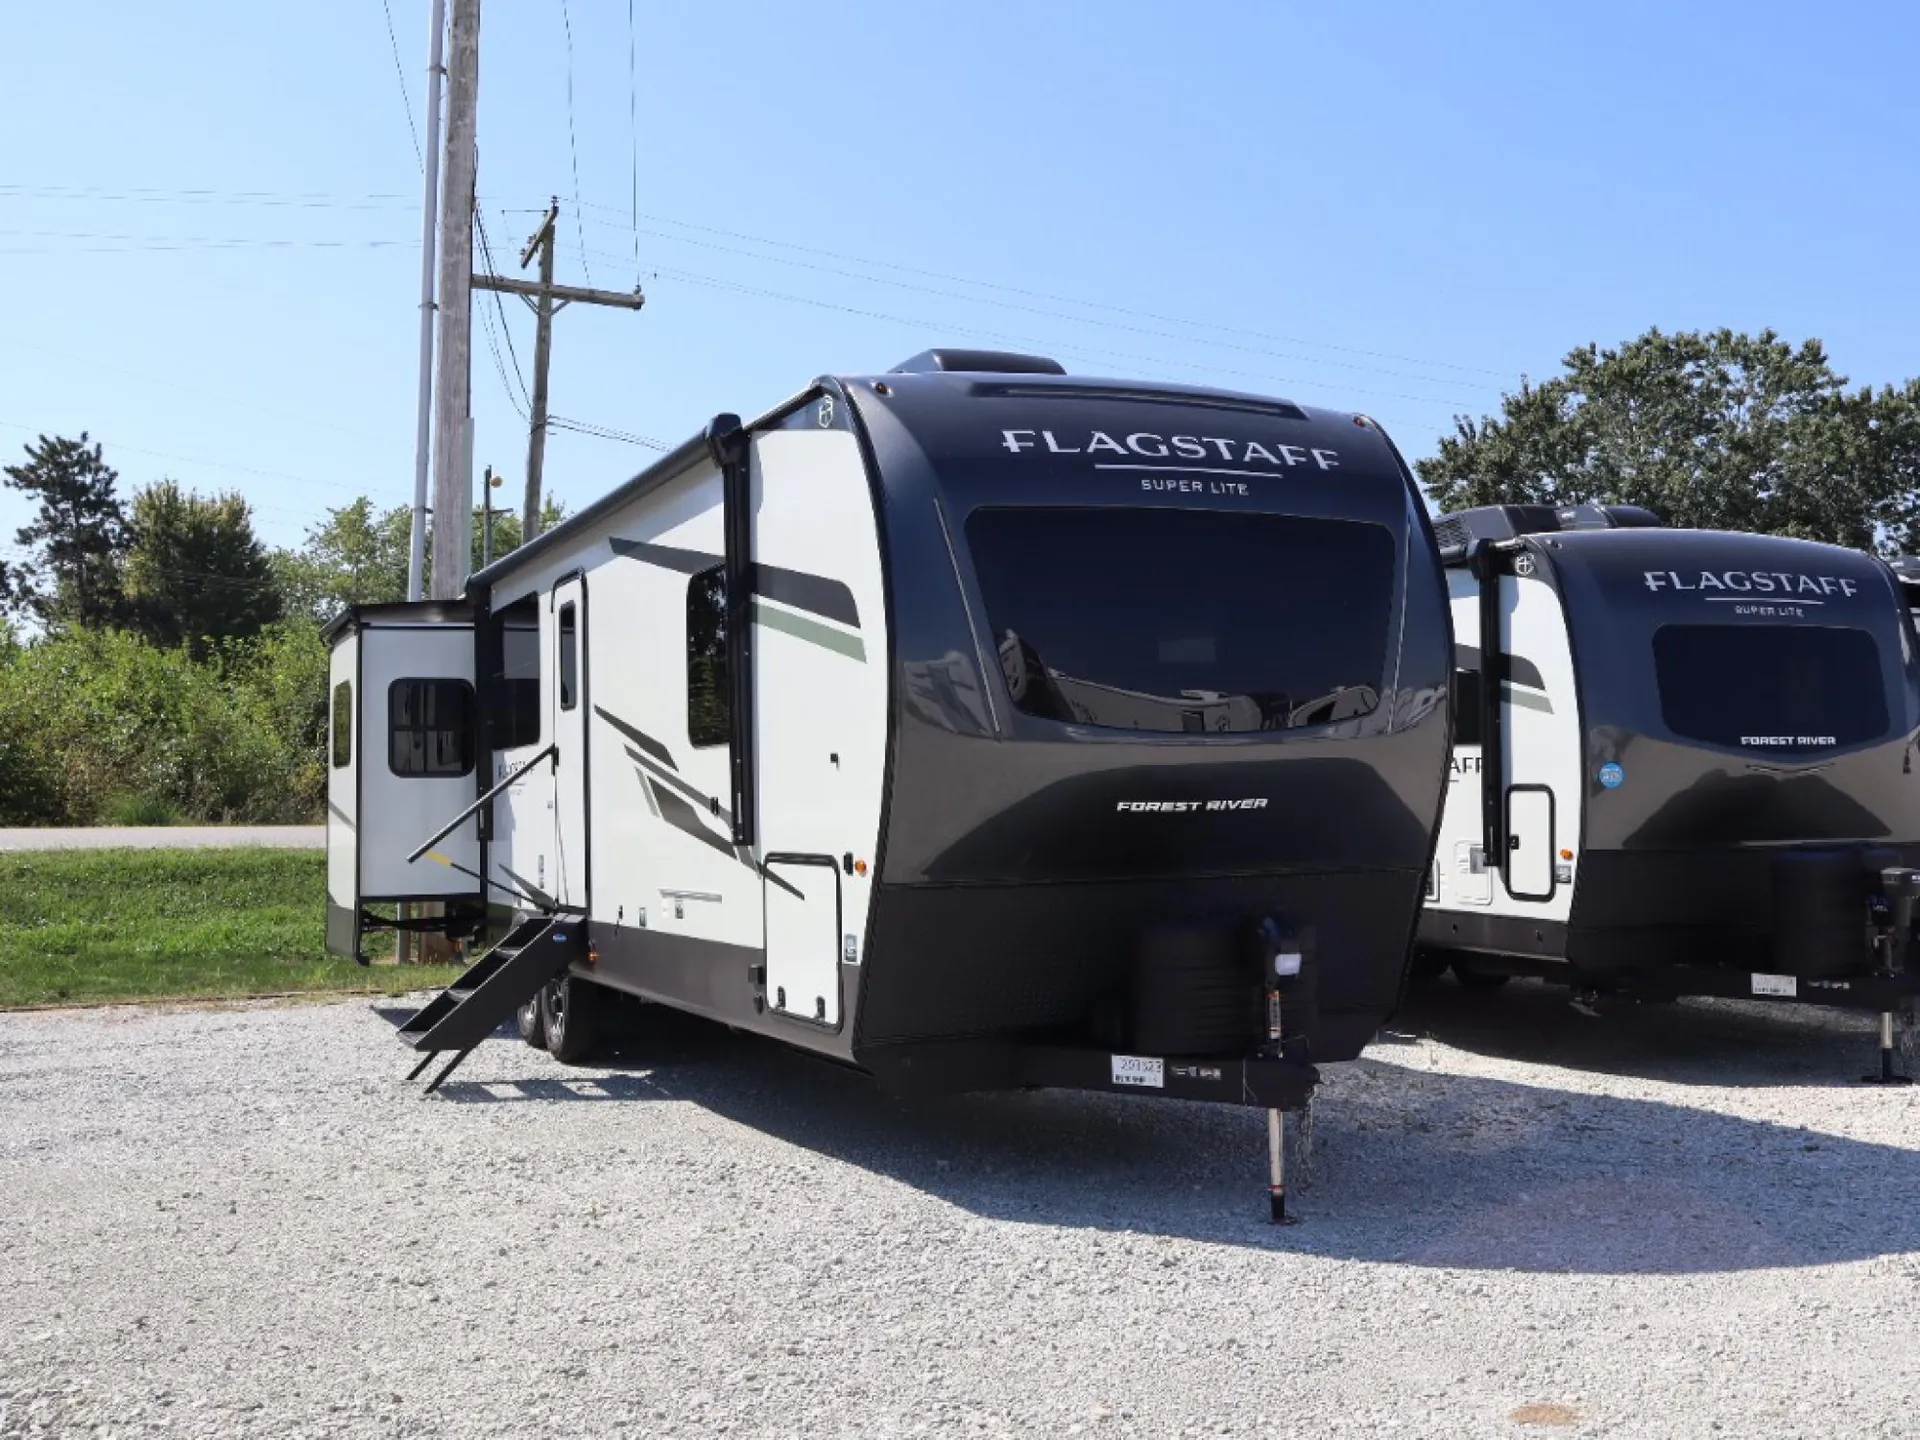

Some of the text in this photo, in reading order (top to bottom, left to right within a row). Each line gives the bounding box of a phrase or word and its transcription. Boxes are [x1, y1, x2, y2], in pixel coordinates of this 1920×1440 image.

[1001, 429, 1341, 472] FLAGSTAFF
[1141, 479, 1250, 496] SUPER LITE
[1643, 571, 1858, 597] FLAGSTAFF
[1735, 605, 1805, 618] SUPER LITE
[1740, 736, 1837, 746] FOREST RIVER
[1116, 798, 1269, 813] FOREST RIVER
